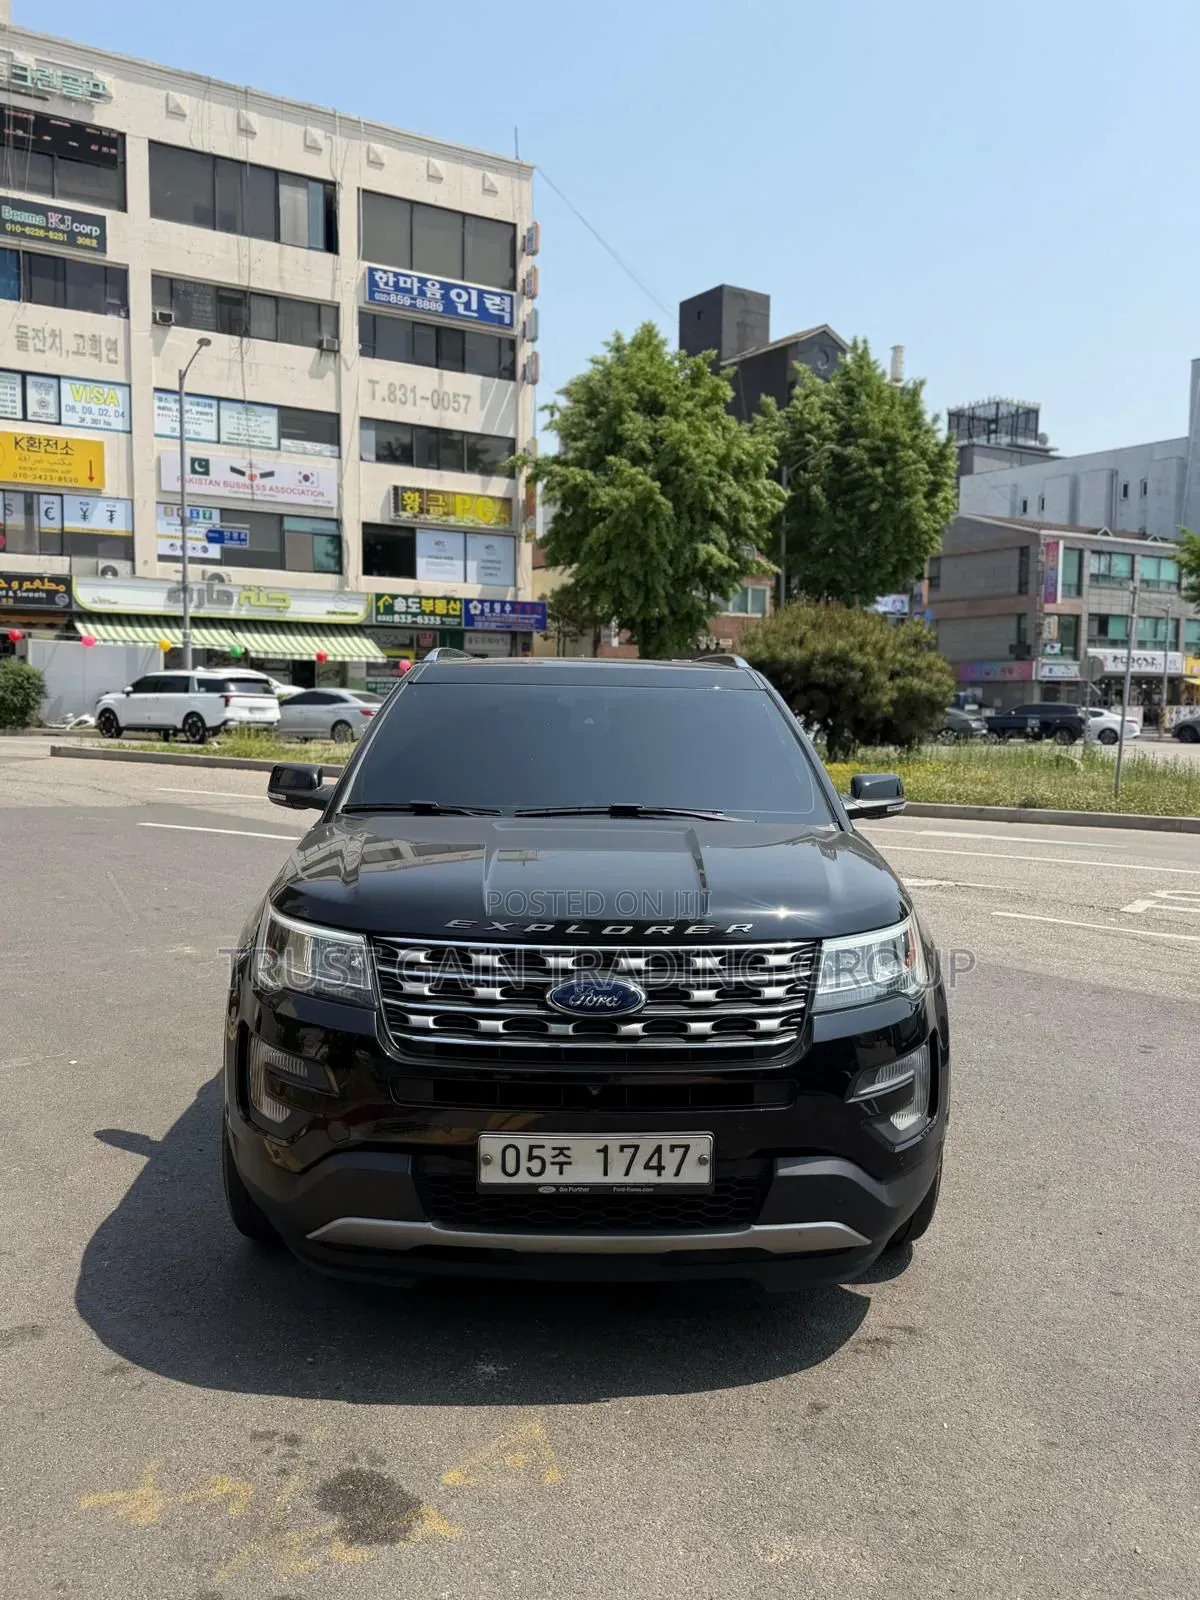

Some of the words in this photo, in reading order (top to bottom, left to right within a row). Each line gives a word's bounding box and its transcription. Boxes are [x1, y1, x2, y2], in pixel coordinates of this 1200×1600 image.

[72, 223, 100, 237] corp
[373, 269, 445, 301] 한마음
[449, 286, 511, 325] 인력
[70, 384, 120, 407] VISA
[367, 379, 473, 414] T.831-0057
[14, 435, 75, 456] K환전소
[222, 481, 268, 493] BUSINESS
[268, 484, 325, 498] ASSOCIATION
[402, 490, 446, 516] 황금
[444, 919, 753, 936] EXPLORER
[568, 985, 624, 1010] Ford
[501, 1143, 573, 1178] 05주
[595, 1143, 692, 1178] 1747
